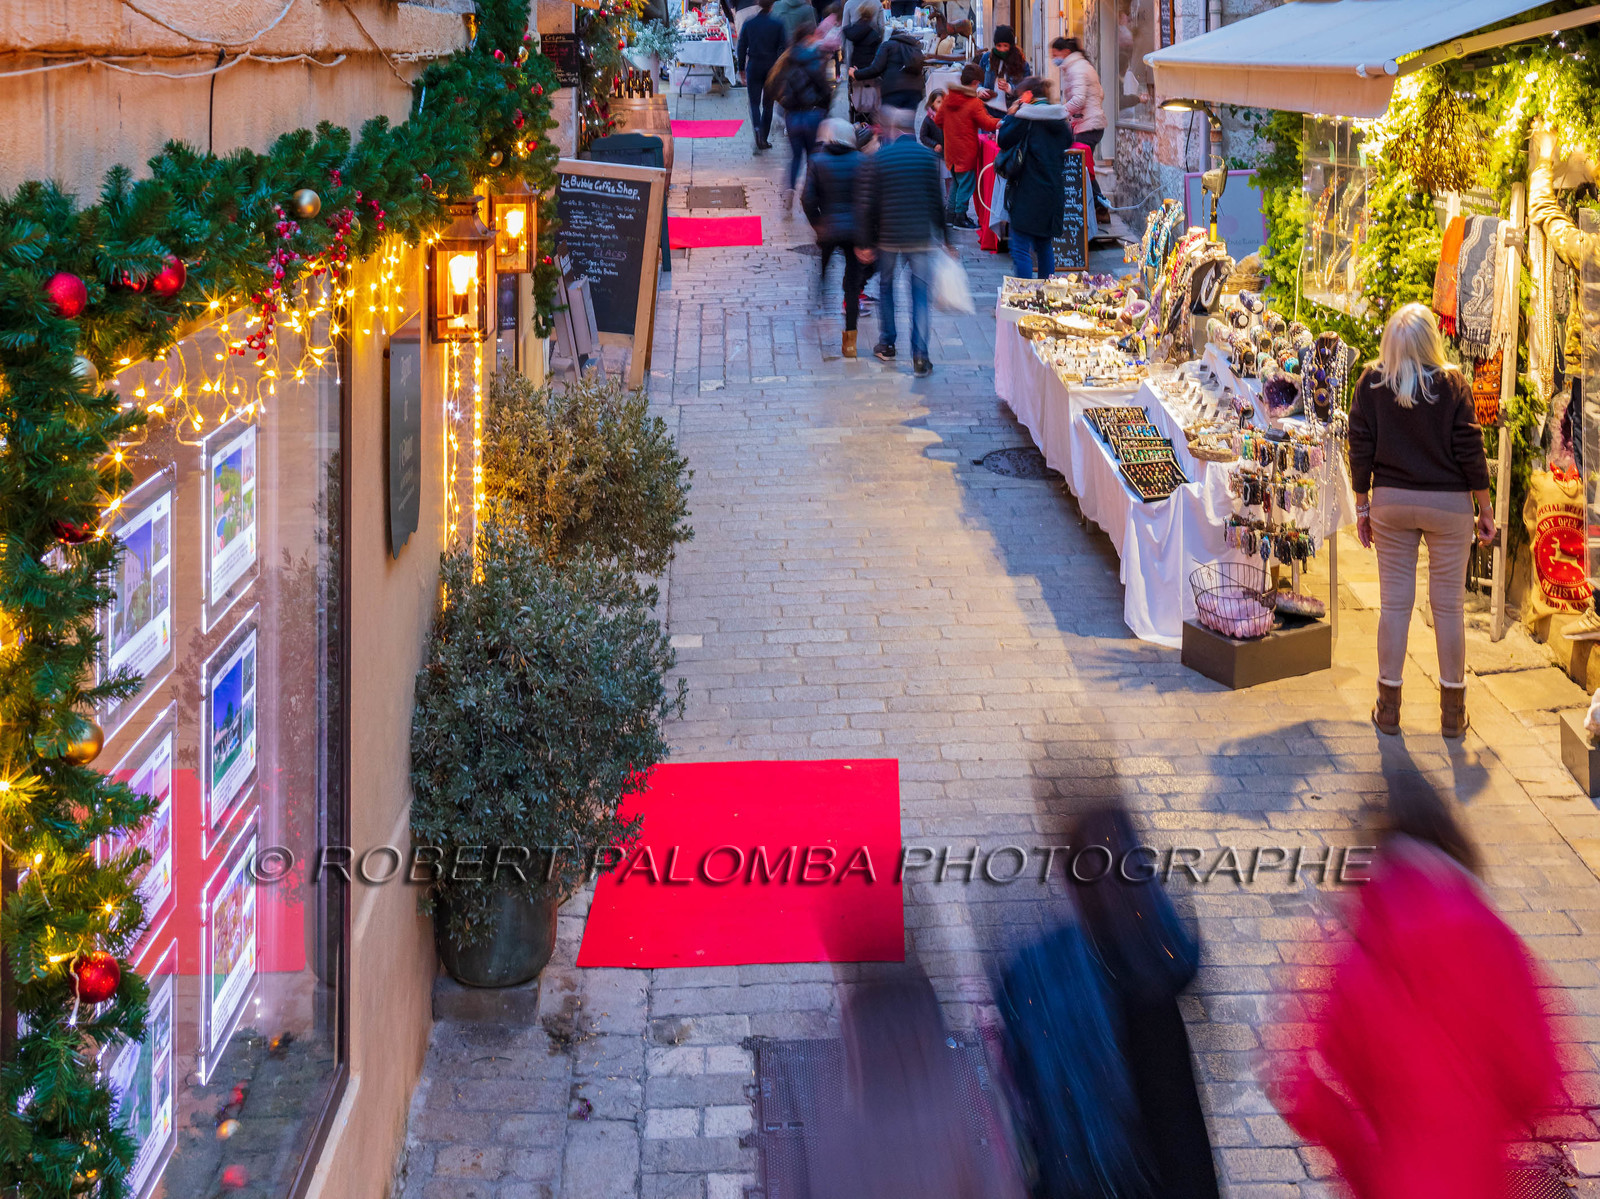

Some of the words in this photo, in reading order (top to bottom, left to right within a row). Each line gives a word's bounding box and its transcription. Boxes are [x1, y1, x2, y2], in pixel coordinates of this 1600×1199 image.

[570, 175, 593, 190] Bubble
[594, 180, 616, 193] Coffee
[616, 181, 639, 199] Shop
[1539, 518, 1555, 532] NOT
[1558, 517, 1577, 528] OPEN
